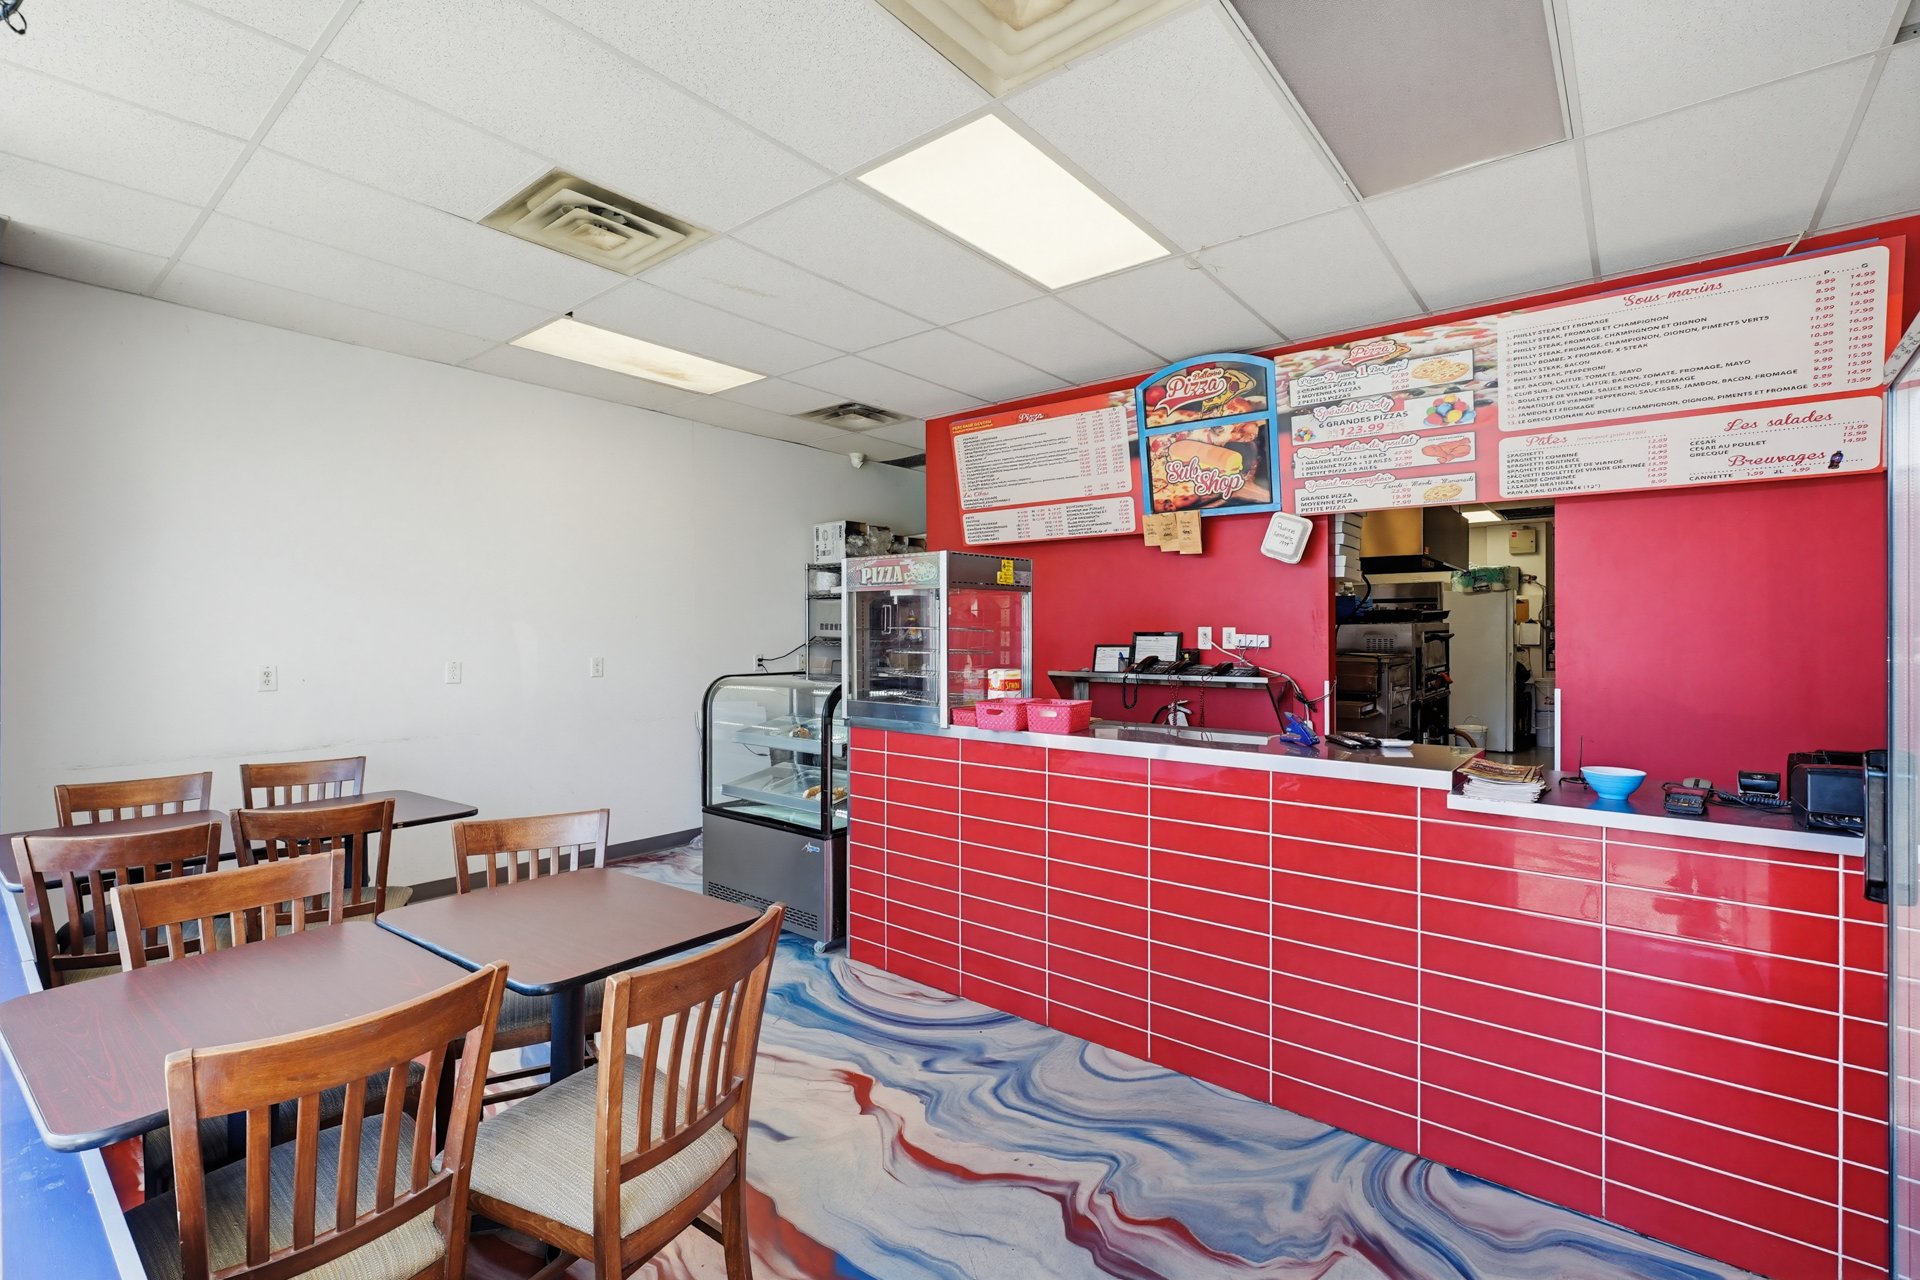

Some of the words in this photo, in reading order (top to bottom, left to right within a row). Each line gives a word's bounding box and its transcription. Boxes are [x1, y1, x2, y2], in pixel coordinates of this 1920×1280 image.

[1624, 281, 1723, 305] Sous-marins
[1513, 339, 1536, 347] PHILLY
[1564, 328, 1601, 338] FROMAGE
[1613, 316, 1669, 329] CHAMPIGNON
[1538, 327, 1560, 335] STEAK
[1572, 319, 1609, 329] FROMAGE
[1539, 342, 1563, 350] STEAK,
[1605, 325, 1660, 339] CHAMPIGNON
[1673, 317, 1707, 327] OIGNON
[1605, 333, 1662, 347] CHAMPIGNON,
[1664, 327, 1700, 337] OIGNON,
[1701, 320, 1739, 331] PIMENTS
[1742, 315, 1770, 324] VERTS
[1564, 366, 1606, 375] PEPPERONI
[1680, 364, 1723, 374] FROMAGE,
[1755, 370, 1798, 379] FROMAGE
[1168, 376, 1224, 397] Pizza
[1655, 376, 1696, 385] FROMAGE
[1718, 391, 1753, 400] PIMENTS
[1766, 385, 1808, 394] FROMAGE
[1326, 416, 1372, 427] GRANDES
[1373, 411, 1409, 421] PIZZAS
[1724, 417, 1758, 431] Les
[1767, 409, 1833, 427] salades
[1339, 423, 1385, 435] 123.99
[1728, 451, 1826, 466] Breuvages
[1166, 458, 1198, 484] Sub
[1195, 470, 1243, 499] Shop
[861, 565, 904, 586] PIZZA
